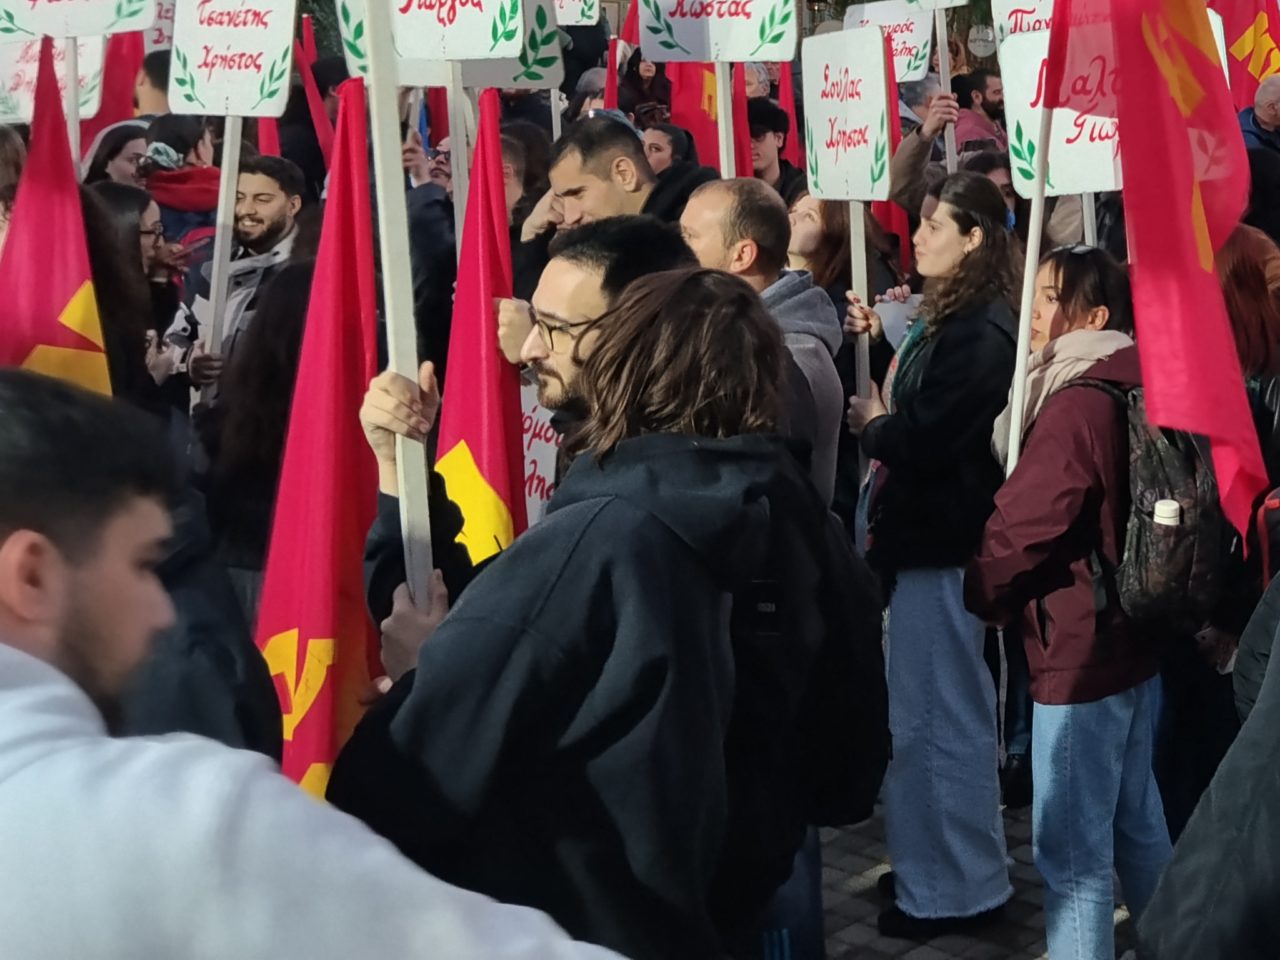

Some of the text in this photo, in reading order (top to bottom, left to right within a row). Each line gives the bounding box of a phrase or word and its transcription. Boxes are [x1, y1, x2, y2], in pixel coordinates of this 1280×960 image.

[197, 44, 264, 83] Χρήστος
[820, 63, 863, 103] Σούλας
[825, 117, 869, 166] Χρήστος
